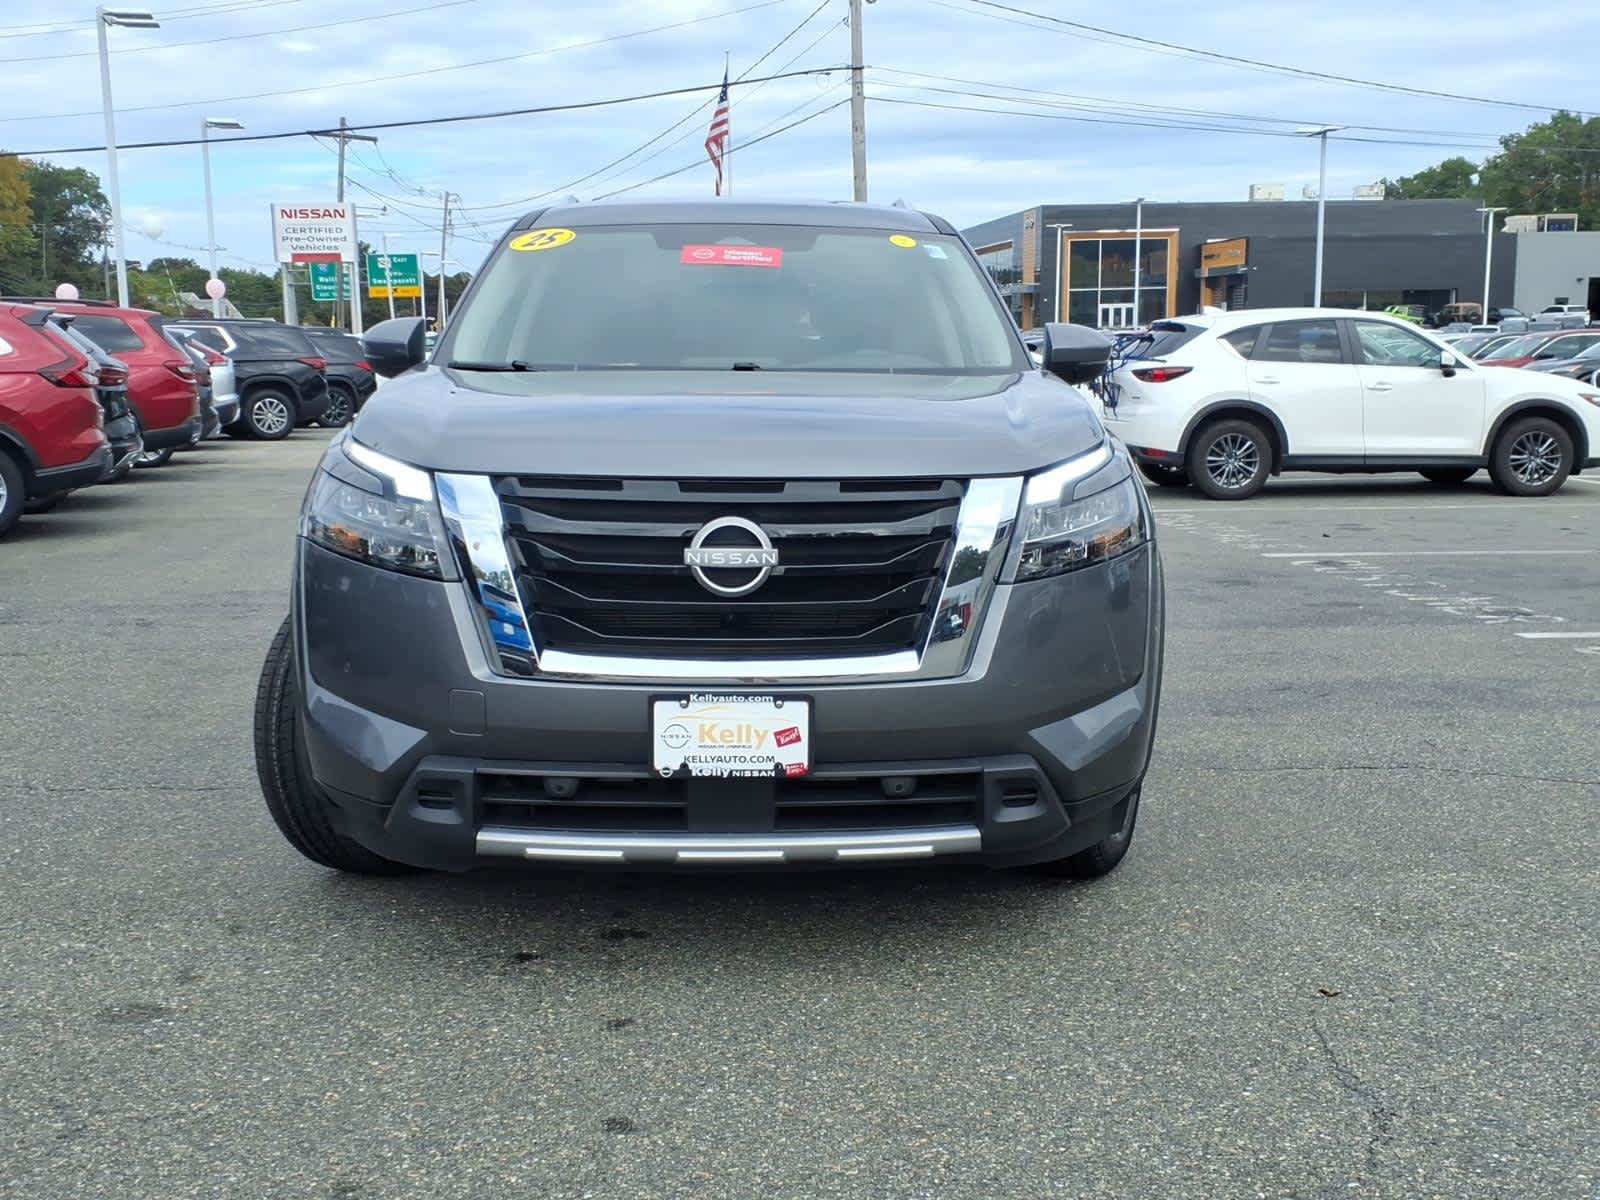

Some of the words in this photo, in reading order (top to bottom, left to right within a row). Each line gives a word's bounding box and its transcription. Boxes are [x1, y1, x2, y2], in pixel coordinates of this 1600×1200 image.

[280, 208, 346, 219] NISSAN
[284, 226, 344, 234] CERTIFIED
[281, 235, 347, 243] Pre-Owned
[520, 231, 565, 248] 25
[290, 243, 340, 251] Vehicles
[686, 551, 776, 565] NISSAN
[689, 693, 774, 703] Kellyauto.com
[698, 723, 769, 751] Kelly
[683, 754, 775, 764] KELLYAUTO.COM
[691, 767, 731, 778] Kelly
[732, 770, 775, 778] NISSAN
